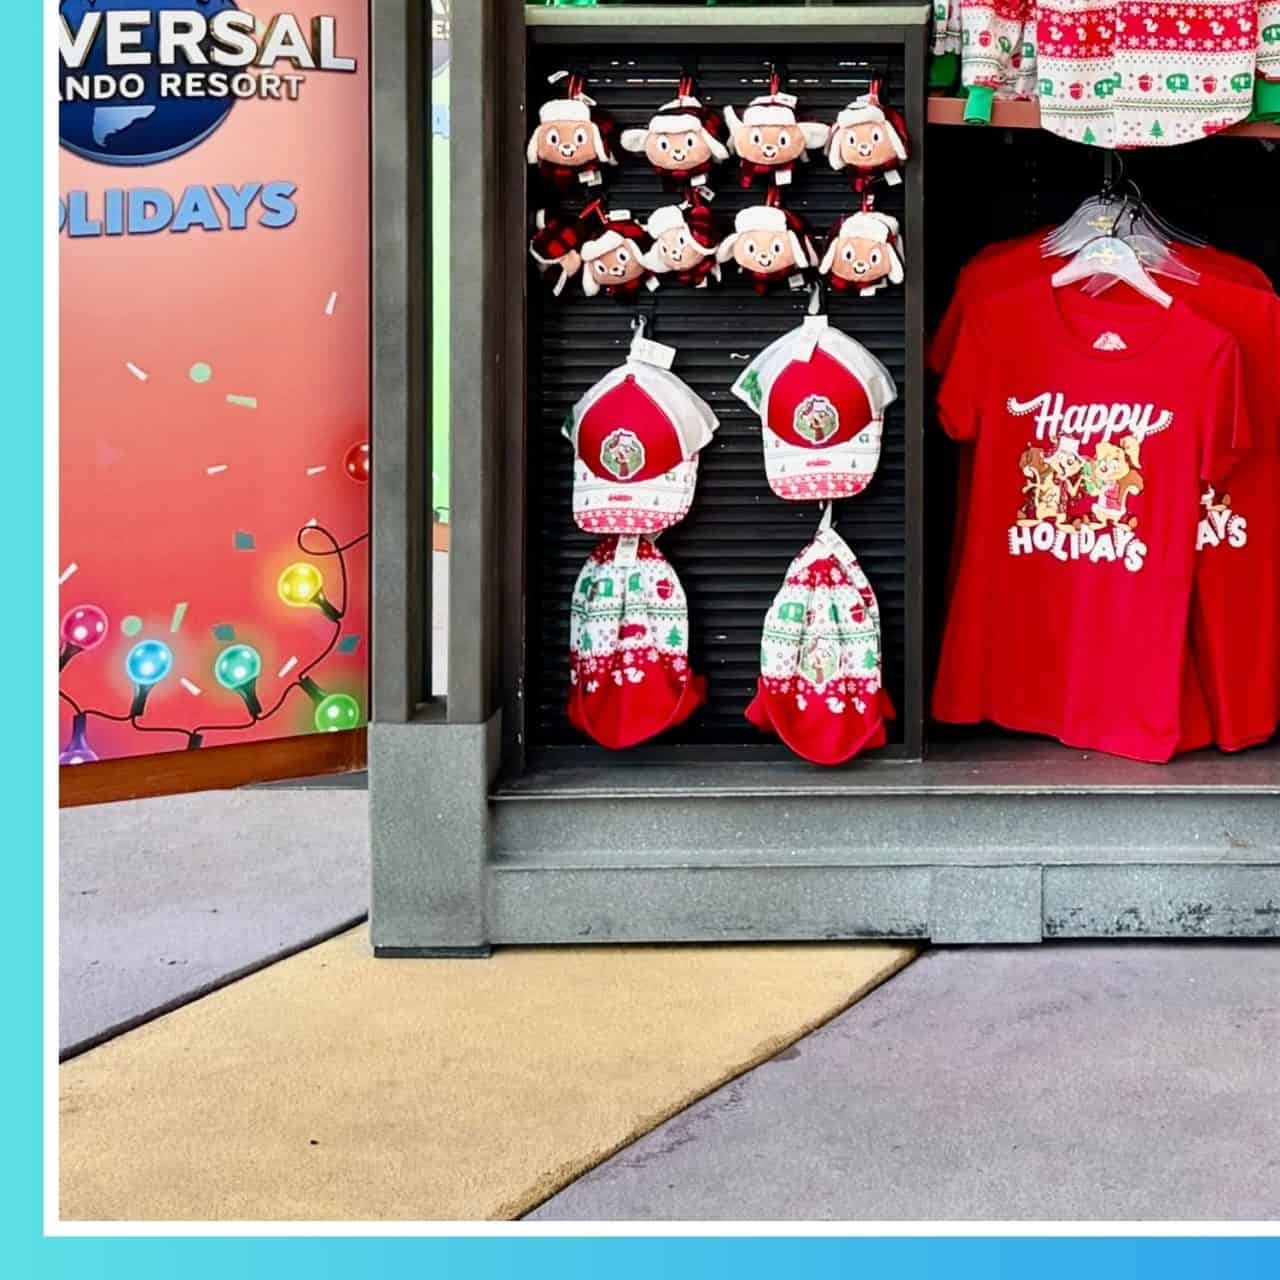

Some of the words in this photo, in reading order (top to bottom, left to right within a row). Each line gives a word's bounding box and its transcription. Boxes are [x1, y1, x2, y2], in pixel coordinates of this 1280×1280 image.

[59, 73, 145, 100] NDO
[160, 73, 304, 100] RESORT
[59, 181, 298, 237] LIDAYS
[1006, 392, 1174, 444] Happy
[1008, 521, 1148, 572] HOLIDAYS
